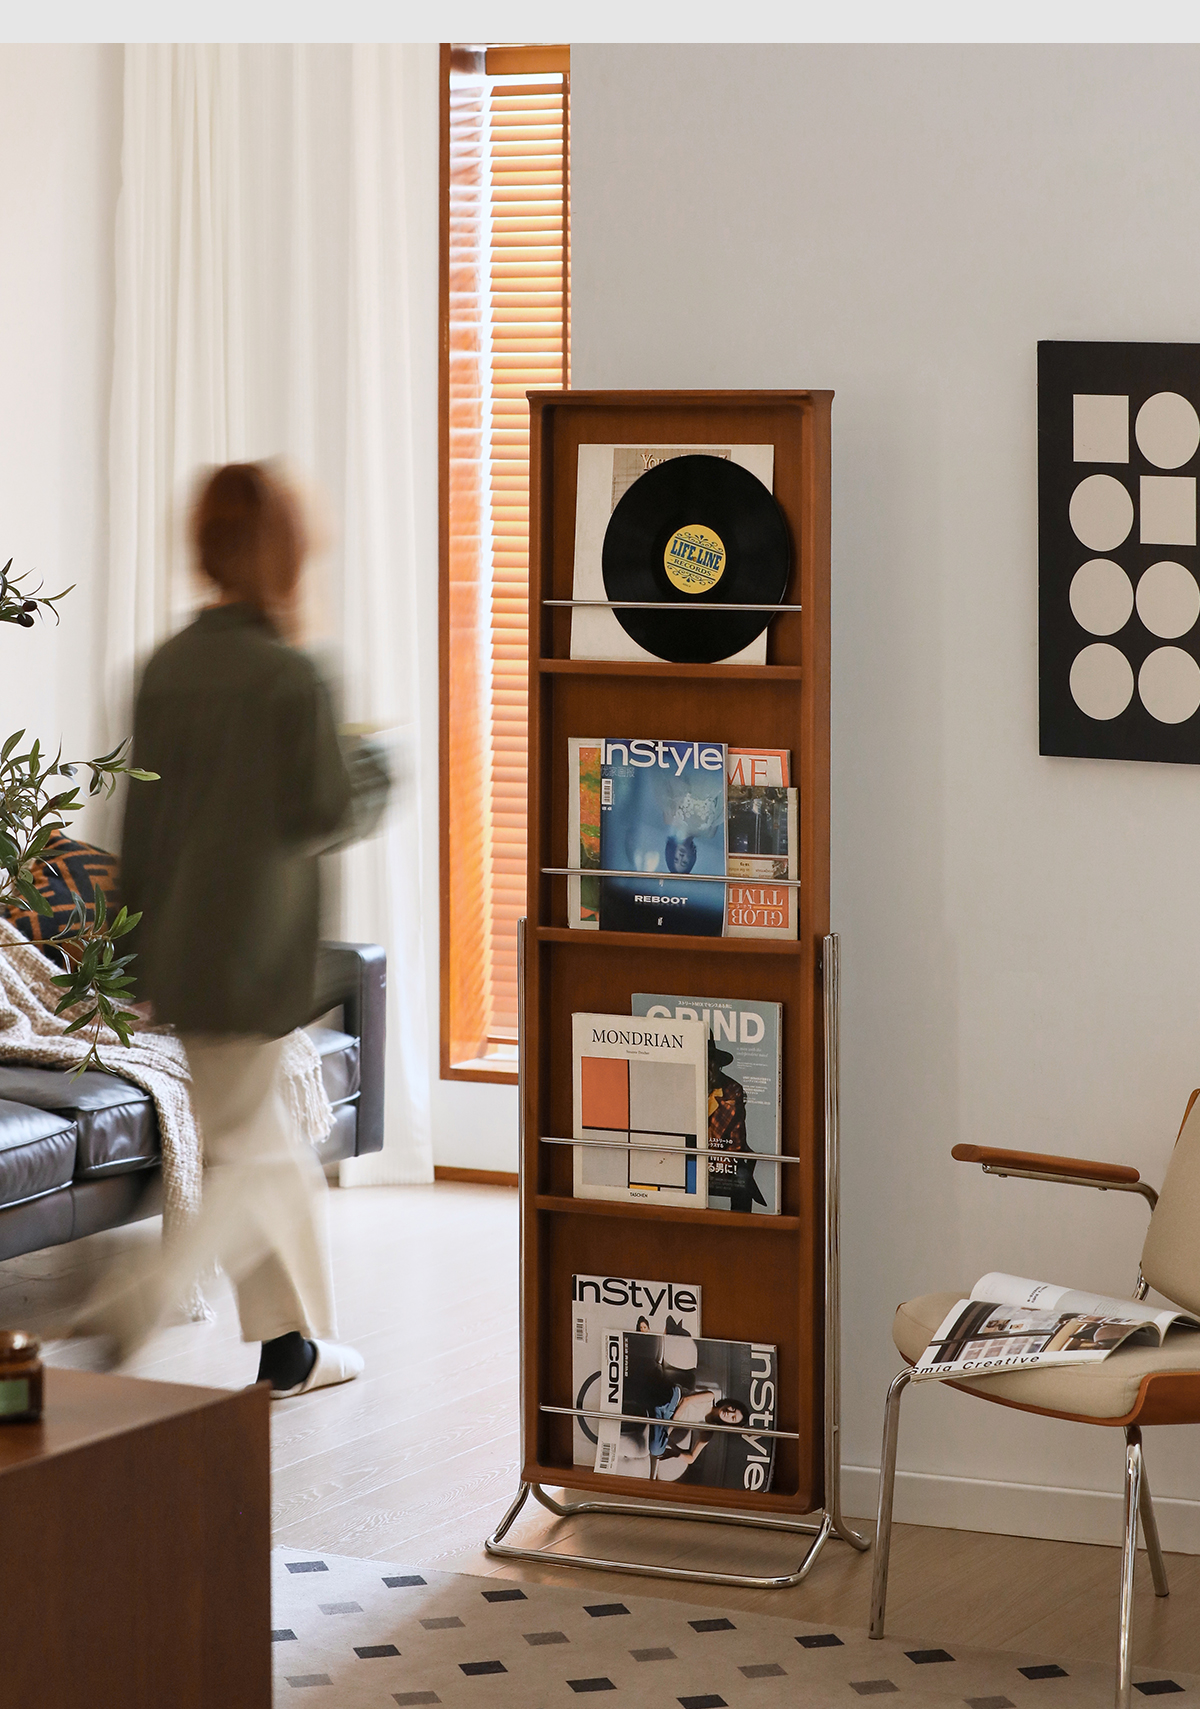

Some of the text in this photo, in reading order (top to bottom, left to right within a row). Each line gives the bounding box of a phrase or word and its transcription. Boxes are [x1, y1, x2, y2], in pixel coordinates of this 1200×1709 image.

[640, 453, 671, 471] Yo
[670, 539, 722, 570] LIFE LINE
[674, 558, 712, 577] RECORDS
[600, 738, 723, 776] InStyle
[634, 894, 689, 905] REBOOT
[728, 908, 784, 927] GLOB
[592, 1028, 684, 1049] MONDRIAN
[572, 1274, 697, 1316] InStyle
[608, 1335, 620, 1404] ICON
[962, 1355, 1040, 1370] Creative
[742, 1344, 775, 1491] InStyle
